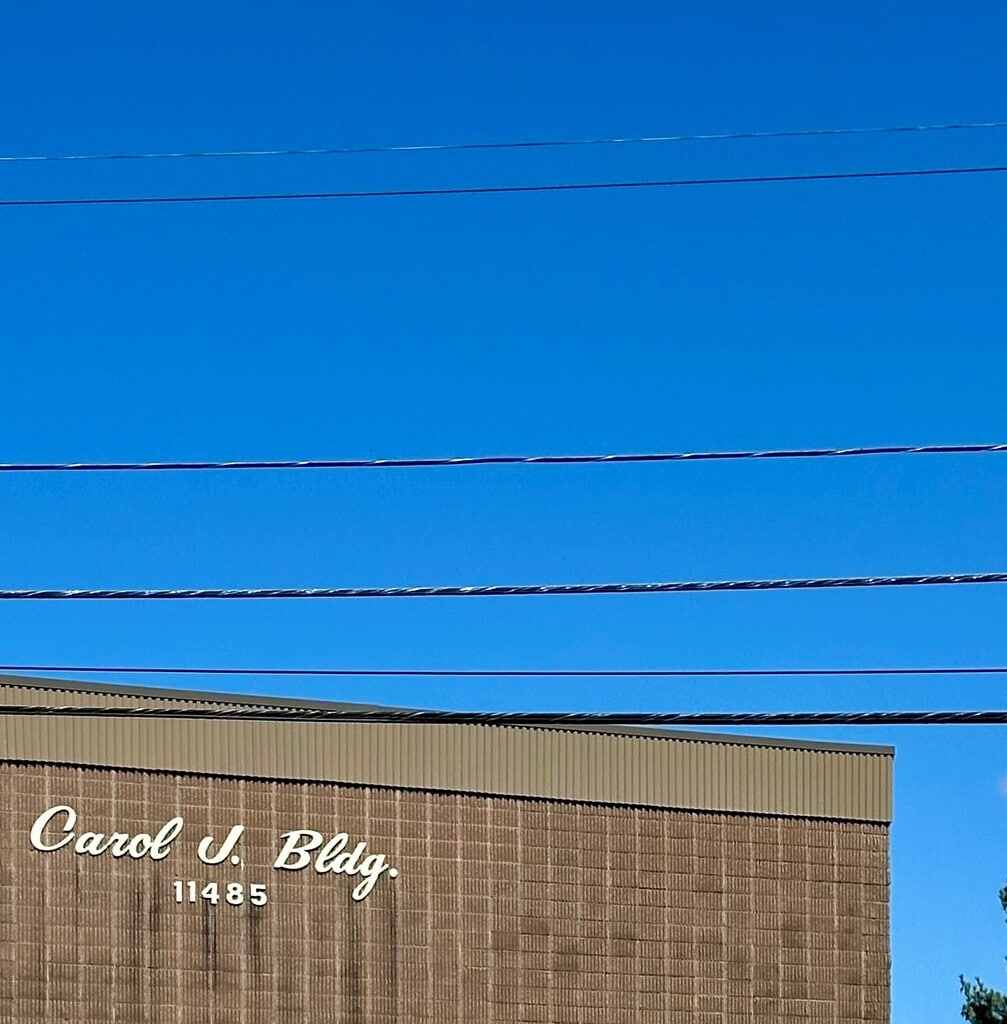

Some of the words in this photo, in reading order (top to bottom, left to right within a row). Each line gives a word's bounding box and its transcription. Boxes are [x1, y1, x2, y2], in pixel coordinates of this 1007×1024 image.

[30, 805, 184, 860] Carol
[198, 824, 245, 865] J.
[274, 829, 400, 901] Bldg.
[173, 879, 268, 906] 11485
